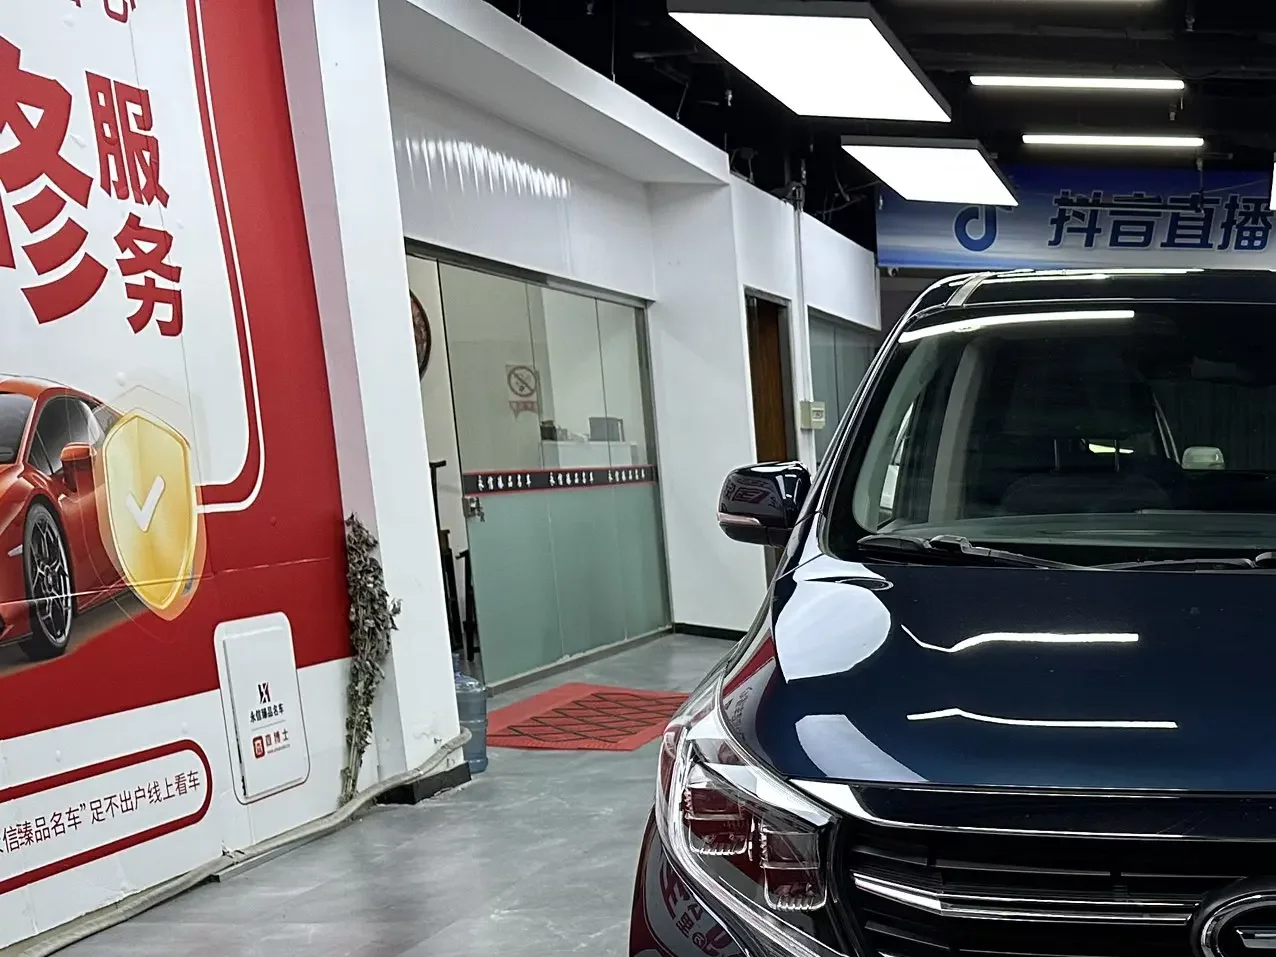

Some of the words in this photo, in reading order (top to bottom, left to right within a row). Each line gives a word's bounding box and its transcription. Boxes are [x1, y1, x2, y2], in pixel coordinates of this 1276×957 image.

[85, 71, 183, 337] 服务
[1048, 191, 1274, 250] 抖音直播
